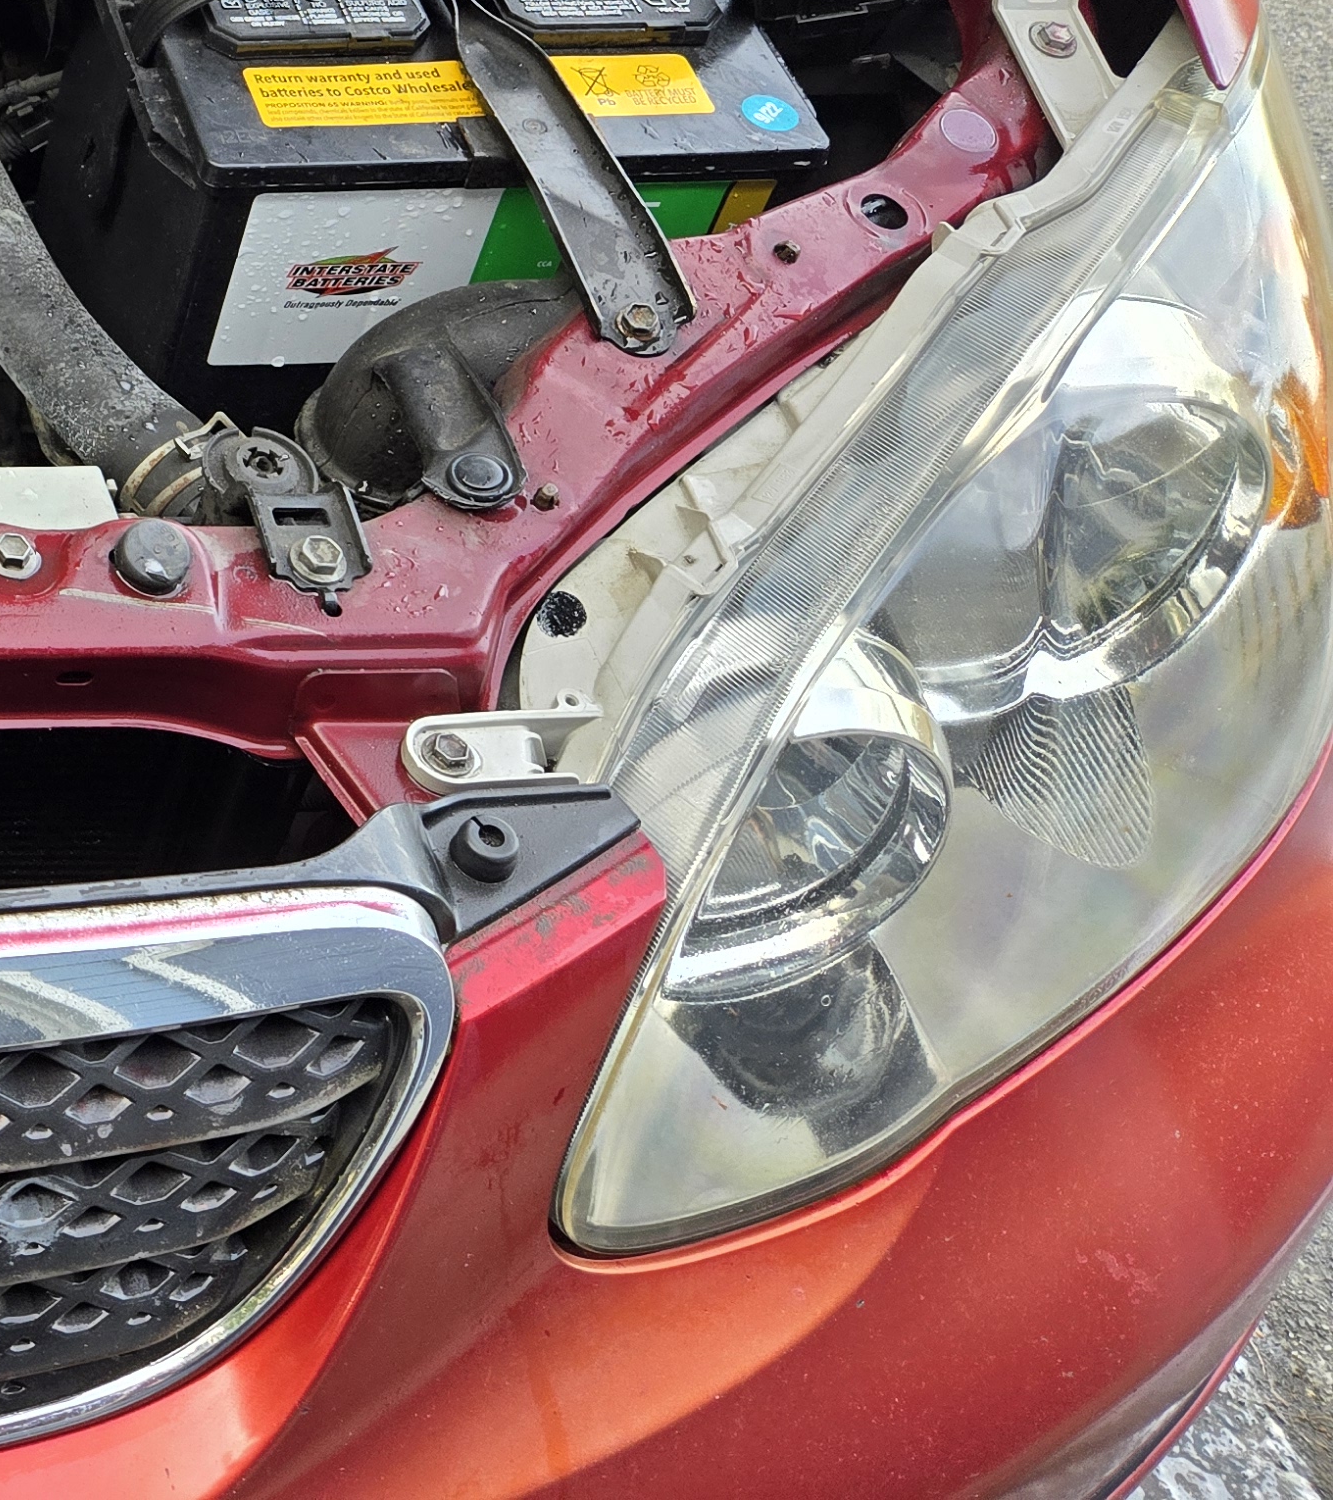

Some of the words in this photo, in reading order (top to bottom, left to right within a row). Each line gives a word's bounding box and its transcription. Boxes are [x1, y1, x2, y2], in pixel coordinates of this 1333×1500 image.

[254, 74, 303, 85] Return
[307, 73, 371, 85] warranty
[375, 69, 402, 81] and
[407, 68, 440, 80] used
[259, 87, 323, 99] batteries
[328, 86, 341, 97] to
[345, 86, 391, 97] Costco
[392, 81, 470, 95] Wholesale
[624, 88, 667, 98] BATTERY
[669, 87, 696, 96] MUST
[598, 97, 616, 106] Pb
[632, 97, 645, 106] BE
[648, 95, 696, 105] RECYCLED
[754, 101, 784, 124] 9/22
[292, 264, 415, 276] INTERSTATE
[292, 275, 401, 288] BATTERIES
[284, 300, 344, 310] Outrageously
